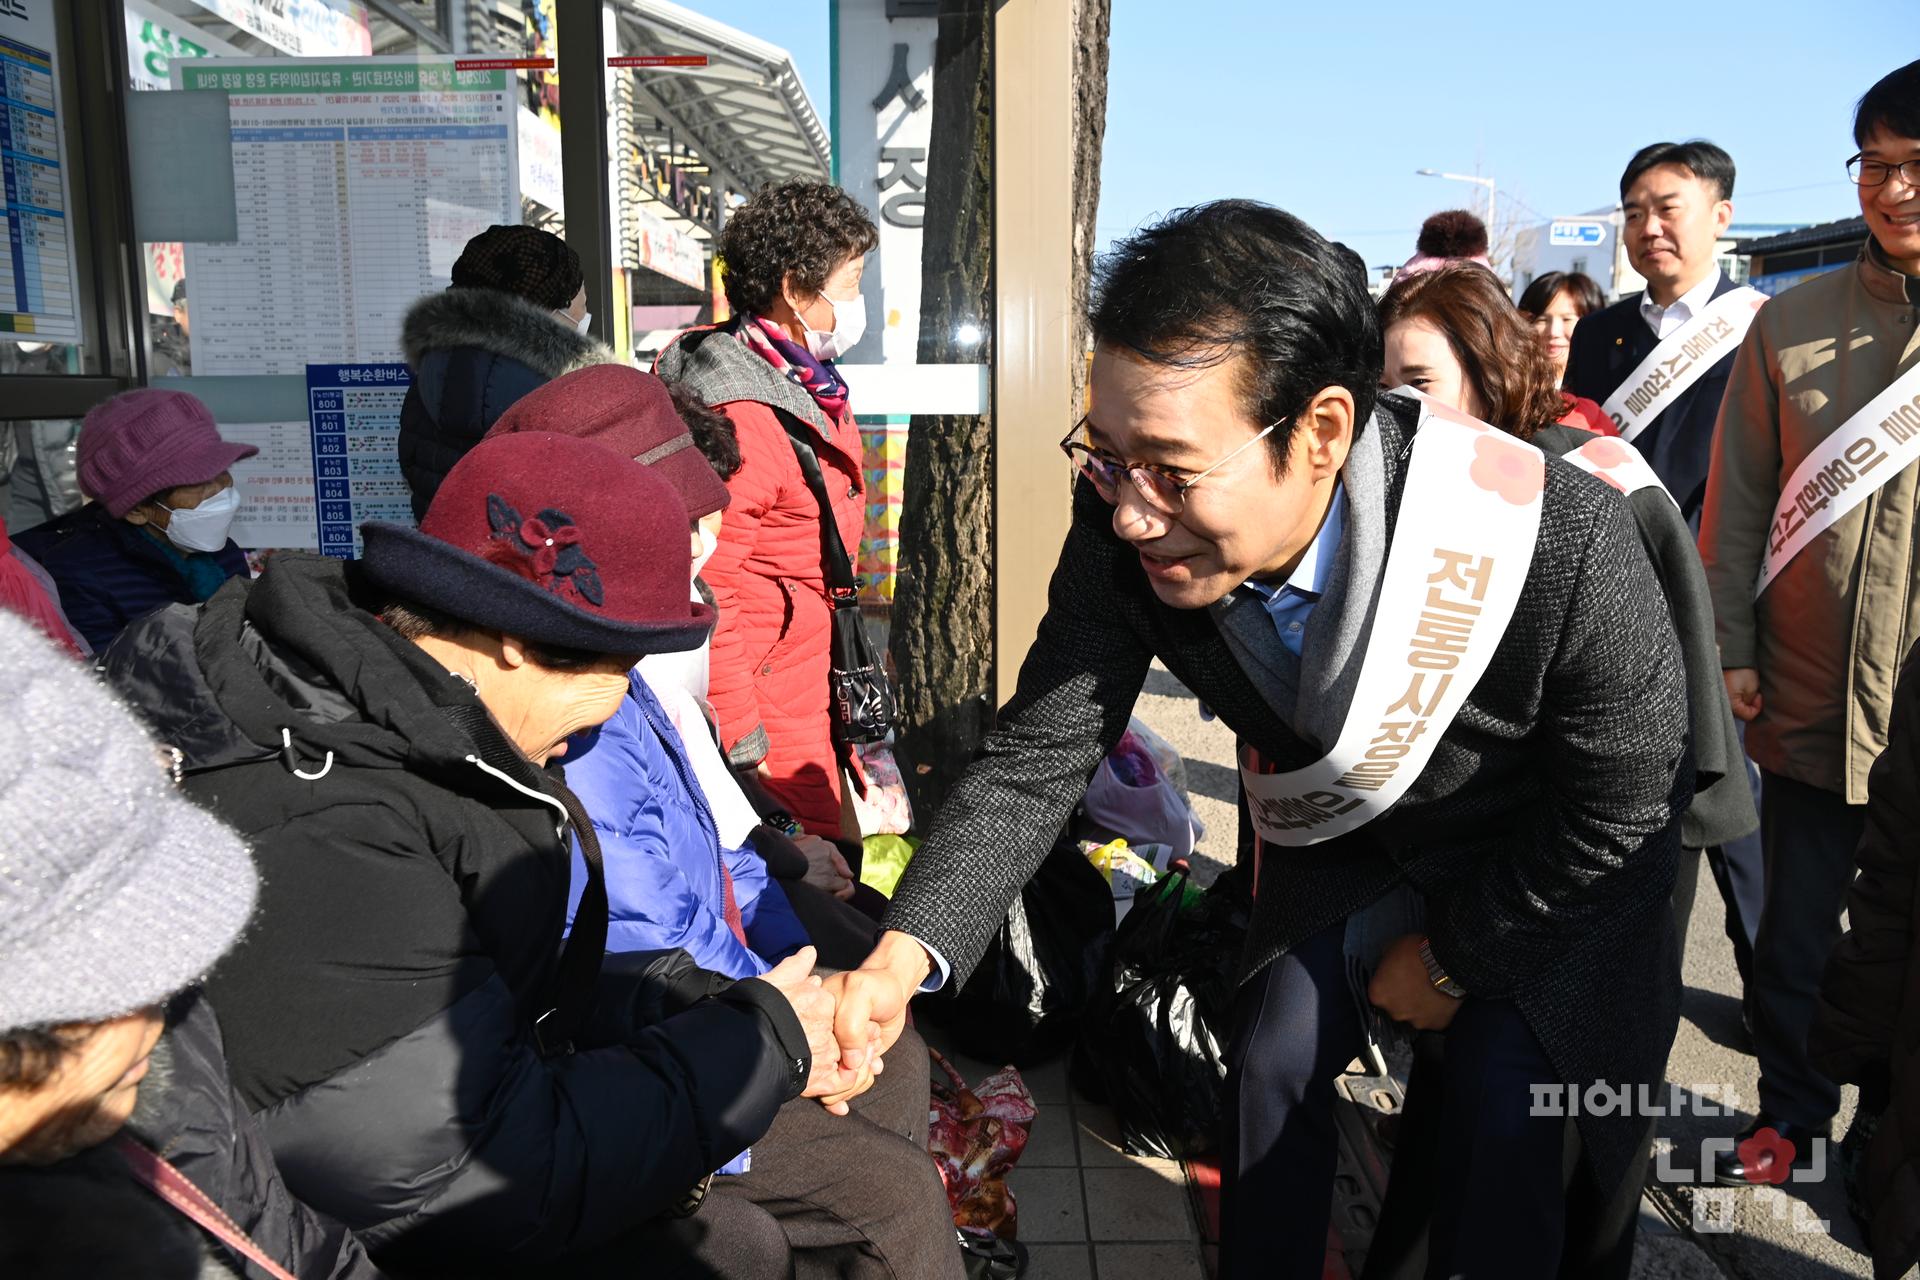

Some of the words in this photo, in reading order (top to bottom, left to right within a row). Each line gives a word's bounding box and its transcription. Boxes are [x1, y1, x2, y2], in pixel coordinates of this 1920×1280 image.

[1624, 316, 1735, 417] 전통시장을
[338, 369, 410, 382] 행복순환버스
[318, 400, 337, 409] 800
[1879, 394, 1920, 446] 을
[321, 422, 339, 431] 801
[322, 444, 340, 453] 802
[324, 467, 342, 476] 803
[325, 489, 343, 498] 804
[1768, 436, 1889, 558] 이용합시다
[327, 511, 345, 520] 805
[328, 533, 347, 542] 806
[1333, 547, 1494, 792] 전통시장을
